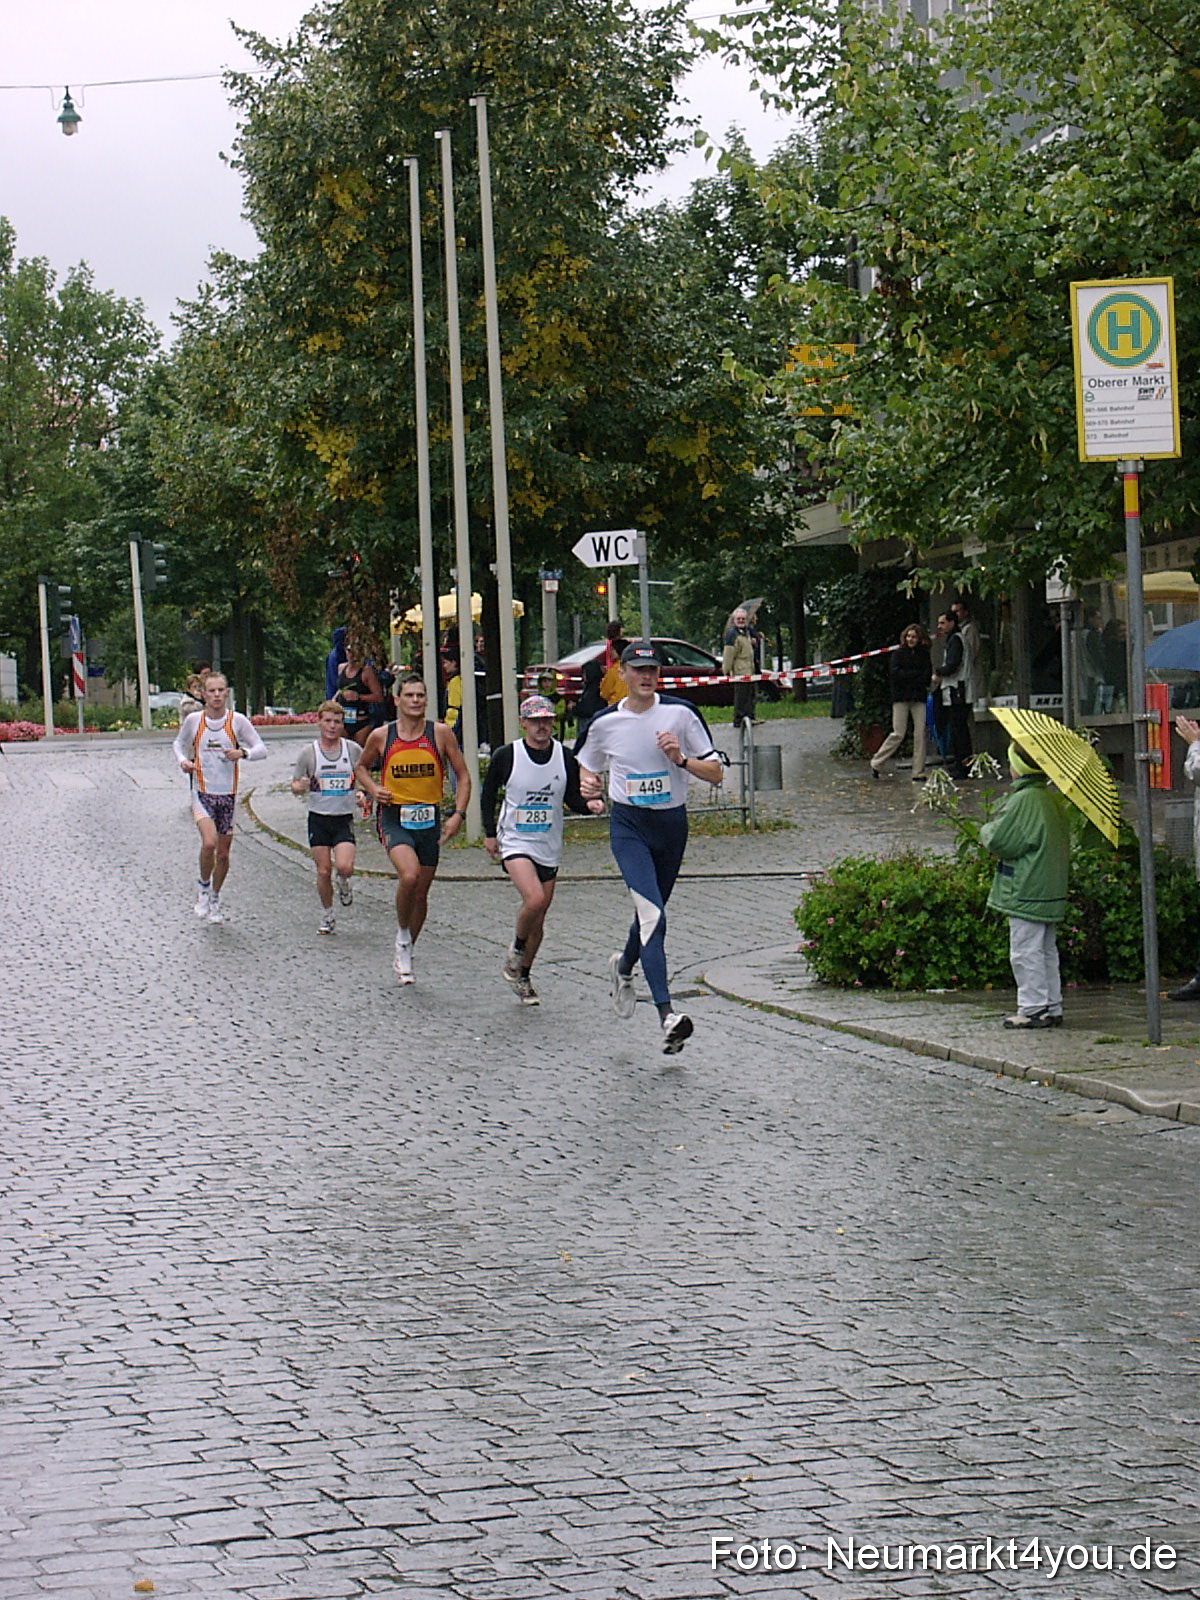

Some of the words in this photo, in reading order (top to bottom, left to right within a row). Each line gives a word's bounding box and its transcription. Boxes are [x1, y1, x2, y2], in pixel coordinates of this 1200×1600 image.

[1108, 310, 1142, 350] H
[1088, 377, 1128, 389] Oberer
[1132, 375, 1165, 386] Markt
[1110, 418, 1135, 426] Bahnhof
[592, 535, 629, 562] WC
[391, 763, 434, 776] HUBER
[329, 779, 345, 789] 522
[638, 778, 663, 794] 449
[410, 808, 429, 822] 203
[525, 810, 548, 823] 283
